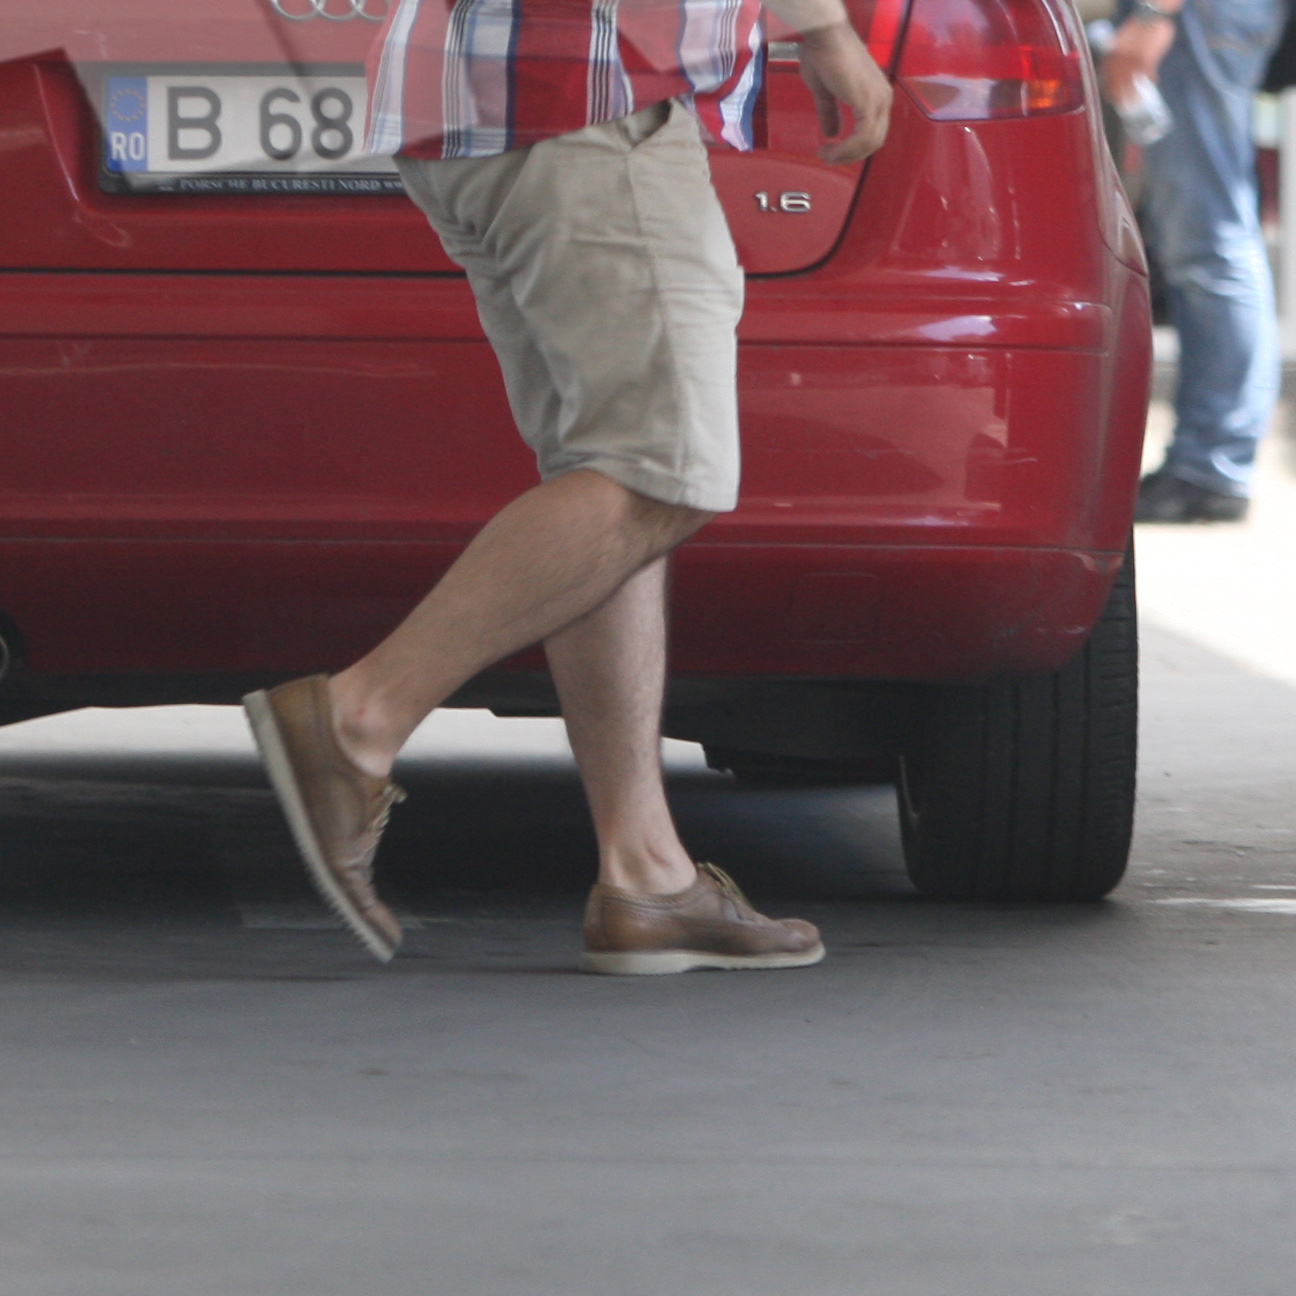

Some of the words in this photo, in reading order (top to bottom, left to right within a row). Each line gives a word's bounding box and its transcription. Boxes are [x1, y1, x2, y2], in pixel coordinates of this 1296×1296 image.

[167, 86, 222, 160] B
[110, 131, 145, 161] RO
[179, 179, 247, 191] PORSCHE
[339, 179, 381, 191] NORD
[754, 191, 812, 213] 1.6
